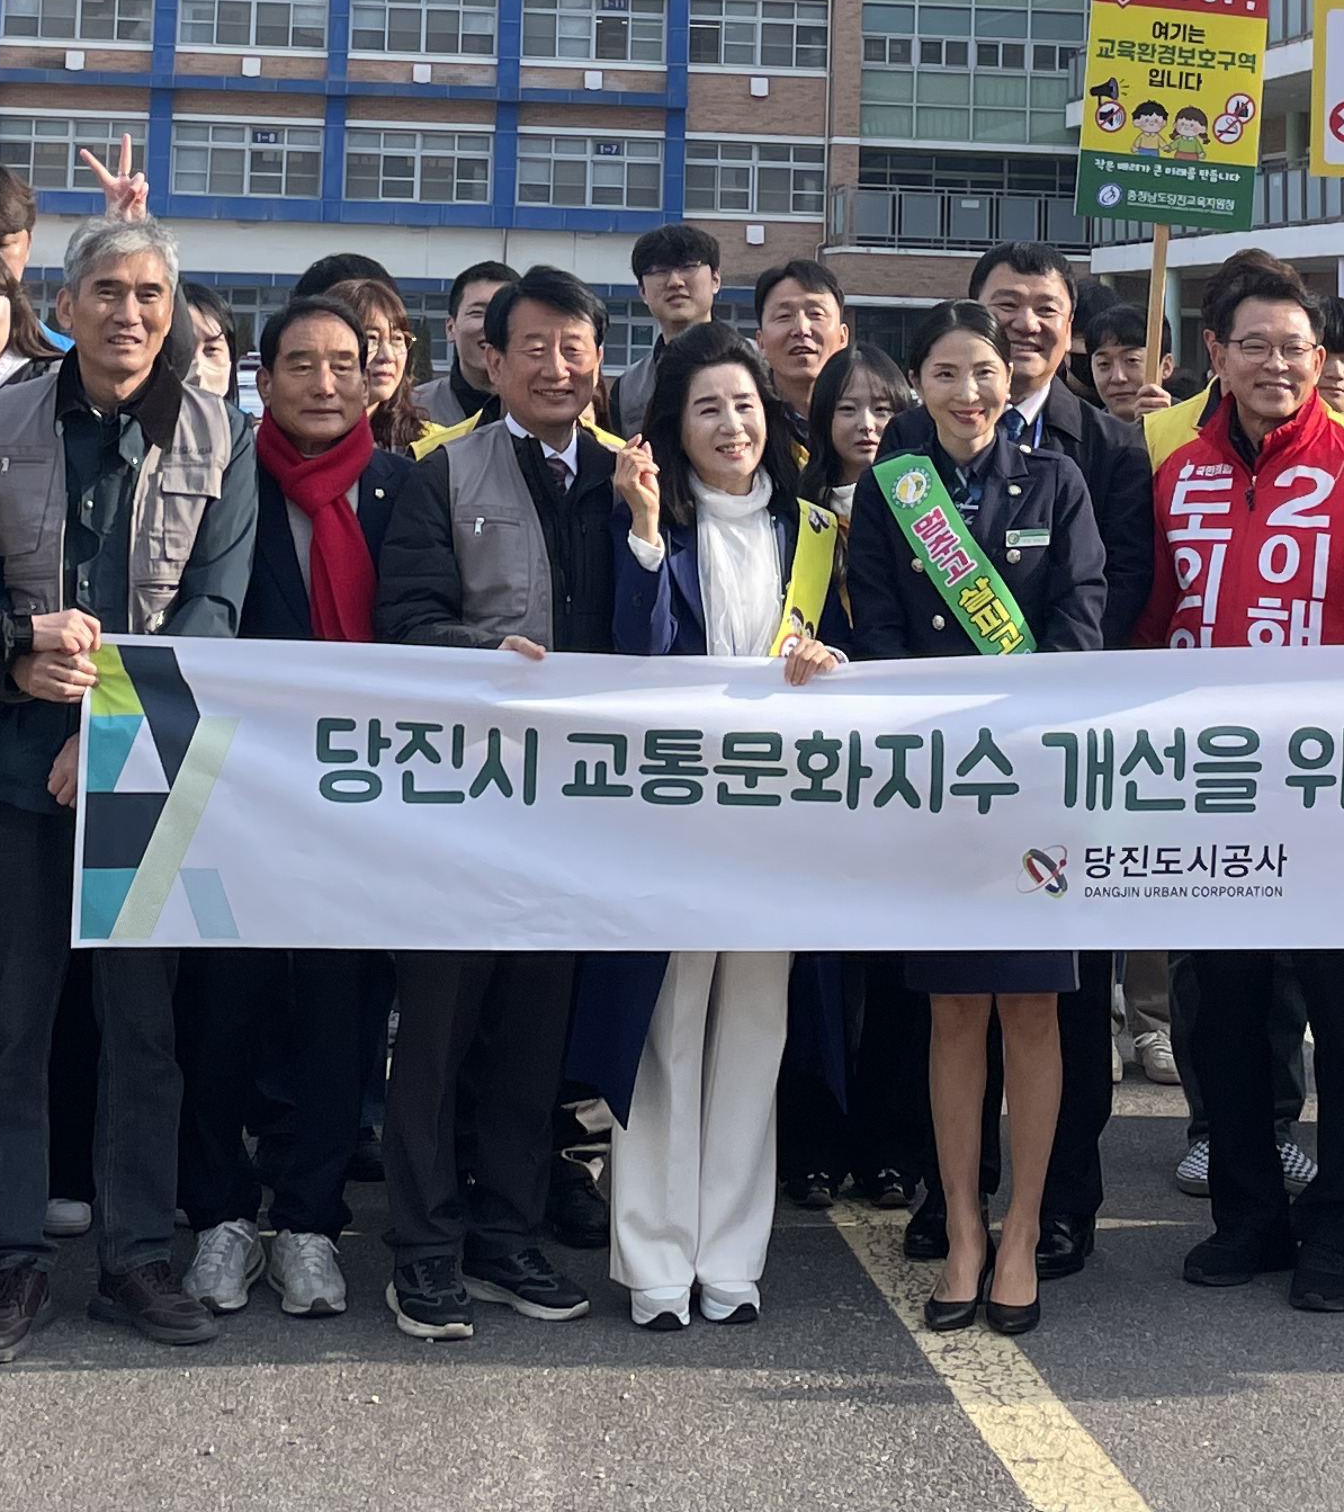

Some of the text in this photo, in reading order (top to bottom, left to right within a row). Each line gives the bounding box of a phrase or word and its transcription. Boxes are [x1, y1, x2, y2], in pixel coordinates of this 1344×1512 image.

[1152, 20, 1206, 44] 여기는
[1096, 39, 1257, 74] 교육환경보호구역
[1148, 68, 1203, 92] 입니다
[600, 145, 618, 155] 1-7
[1094, 158, 1115, 173] 작은
[1116, 161, 1152, 174] 배려가
[1153, 163, 1163, 177] 큰
[1164, 166, 1197, 181] 미래를
[1127, 189, 1235, 211] 충청남도당진교육지원청
[1266, 464, 1335, 528] 2
[910, 504, 979, 589] 멈추고
[958, 575, 1025, 656] 살피고
[315, 716, 539, 807] 당진시
[561, 727, 1020, 815] 교통문화지수
[1041, 725, 1263, 814] 개선을
[1084, 842, 1288, 880] 당진도시공사
[1084, 885, 1284, 898] DANGJIN URBAN CORPORATION
